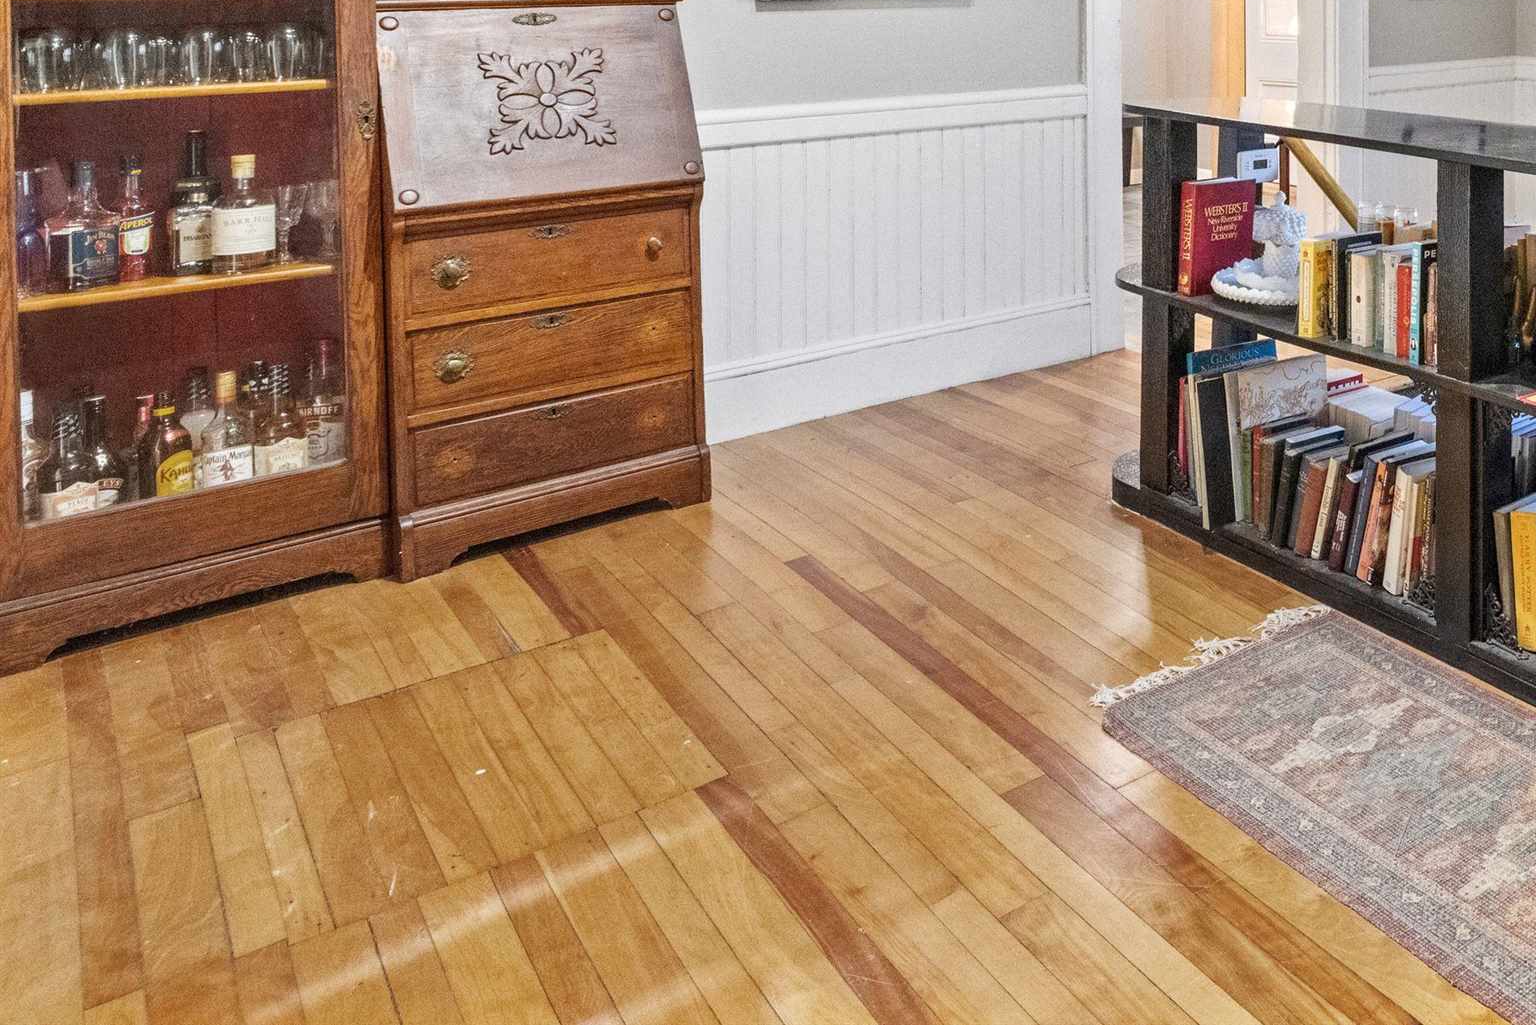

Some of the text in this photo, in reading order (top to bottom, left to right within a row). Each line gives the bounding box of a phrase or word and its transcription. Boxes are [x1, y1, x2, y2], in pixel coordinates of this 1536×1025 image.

[1242, 202, 1249, 213] II
[119, 217, 153, 232] APEROL
[1213, 223, 1237, 233] University
[1210, 232, 1238, 241] Dictionary
[1411, 248, 1420, 324] PERSEPOLIS
[299, 404, 340, 418] MIRNOFF
